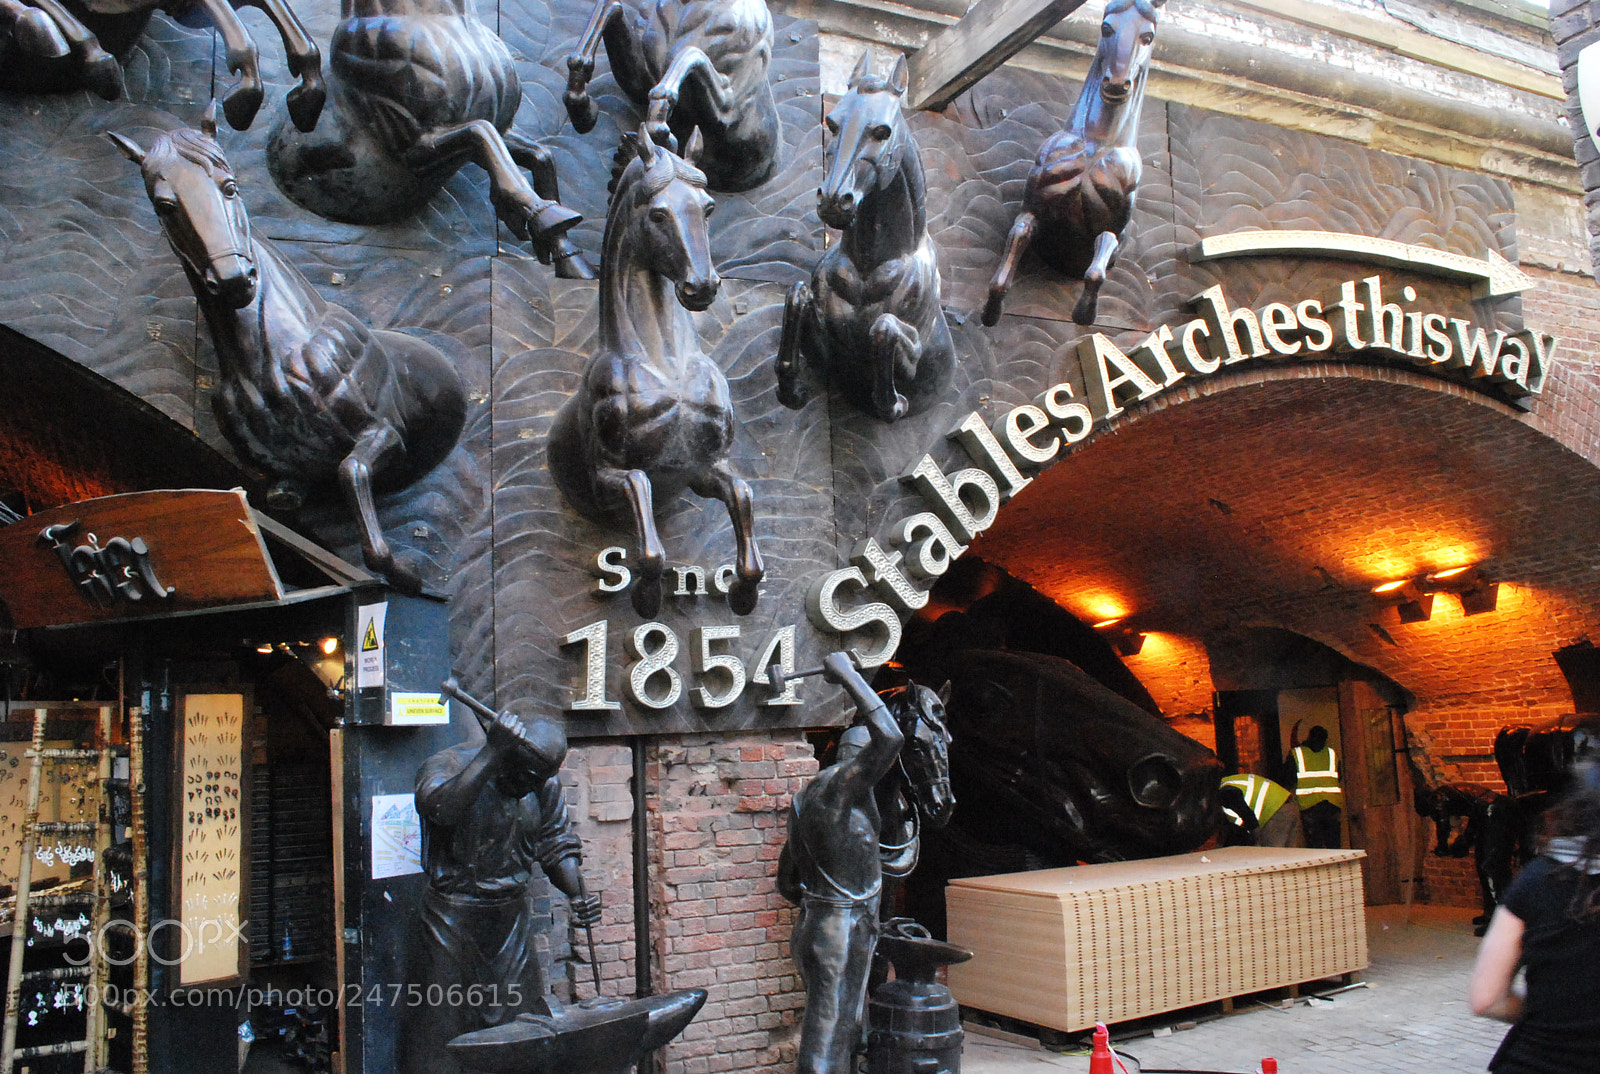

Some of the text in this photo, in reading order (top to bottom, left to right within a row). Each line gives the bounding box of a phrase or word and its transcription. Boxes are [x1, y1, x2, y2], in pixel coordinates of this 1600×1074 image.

[820, 275, 1560, 668] Stables Arches this way
[597, 546, 766, 595] Snc
[566, 620, 805, 710] 1854
